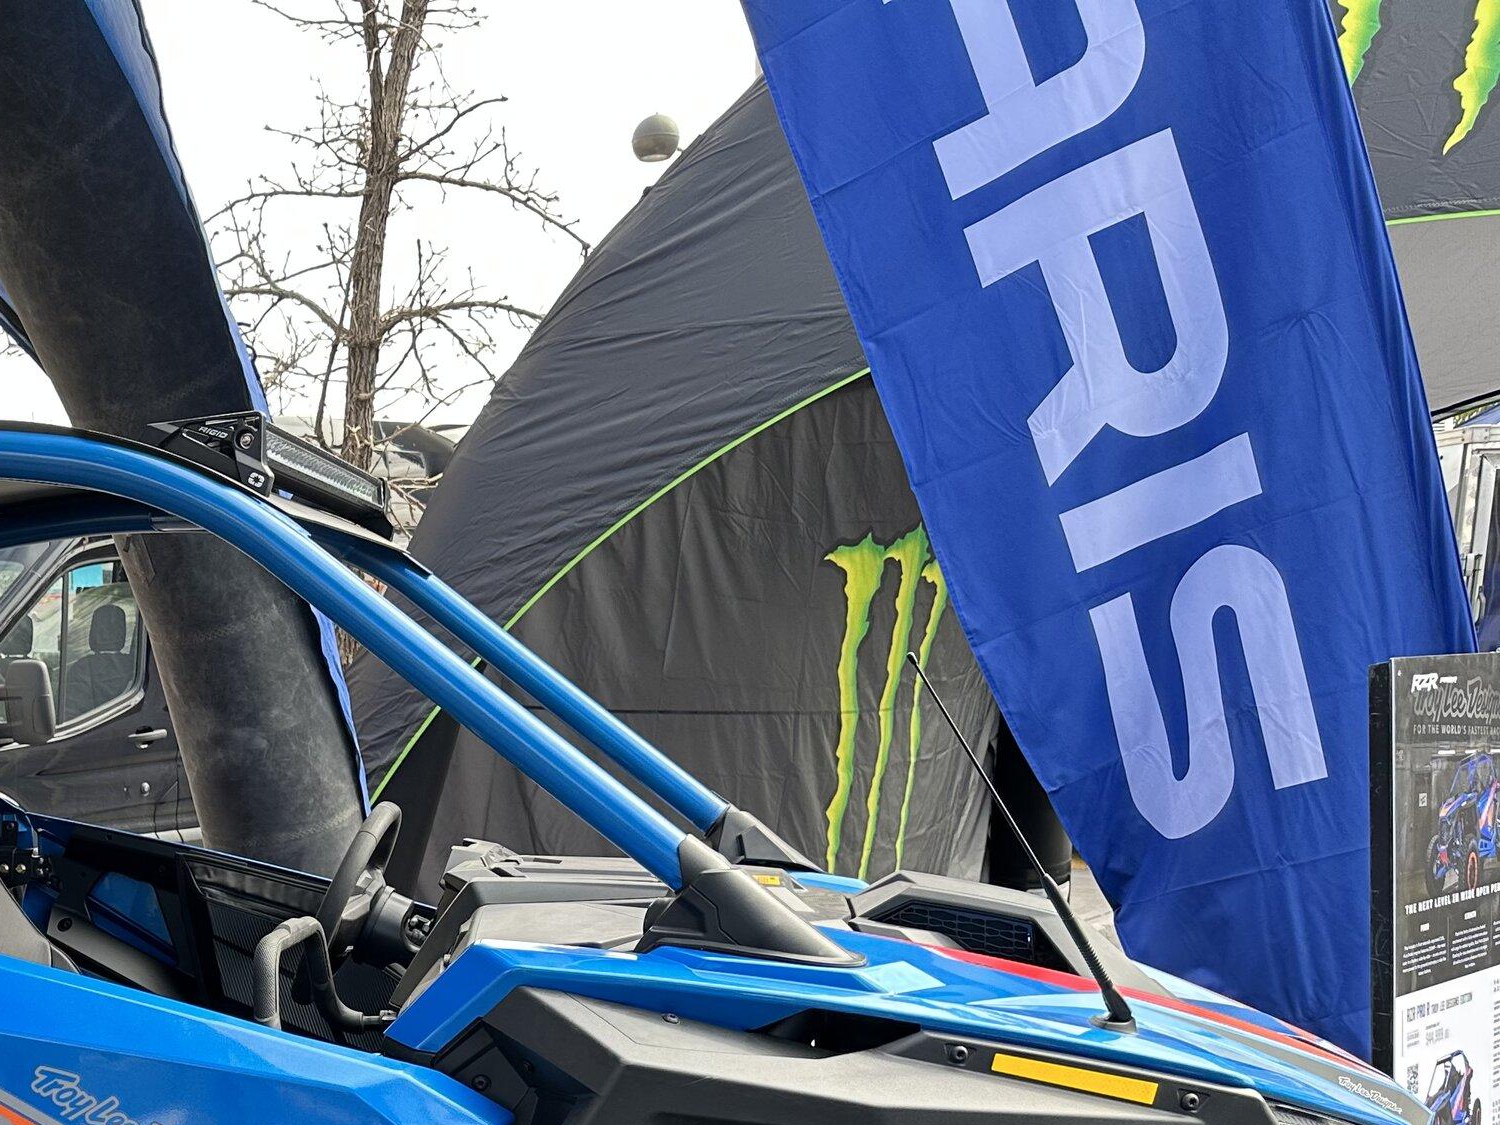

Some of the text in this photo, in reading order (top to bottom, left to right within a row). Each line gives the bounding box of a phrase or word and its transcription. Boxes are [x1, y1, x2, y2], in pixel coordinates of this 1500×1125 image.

[197, 425, 230, 440] RIGID
[1411, 672, 1439, 693] RZR
[1413, 724, 1426, 735] FOR
[1428, 724, 1440, 735] THE
[1441, 724, 1467, 735] WORLD'S
[1468, 726, 1489, 736] FASTEST
[1405, 902, 1418, 915] THE
[1418, 898, 1433, 912] NEXT
[1434, 894, 1451, 908] LEVEL
[1461, 888, 1475, 901] WIDE
[1475, 885, 1490, 898] OPEN
[31, 1064, 96, 1123] Troy
[1338, 1075, 1355, 1093] Troy
[1354, 1083, 1371, 1099] Lee
